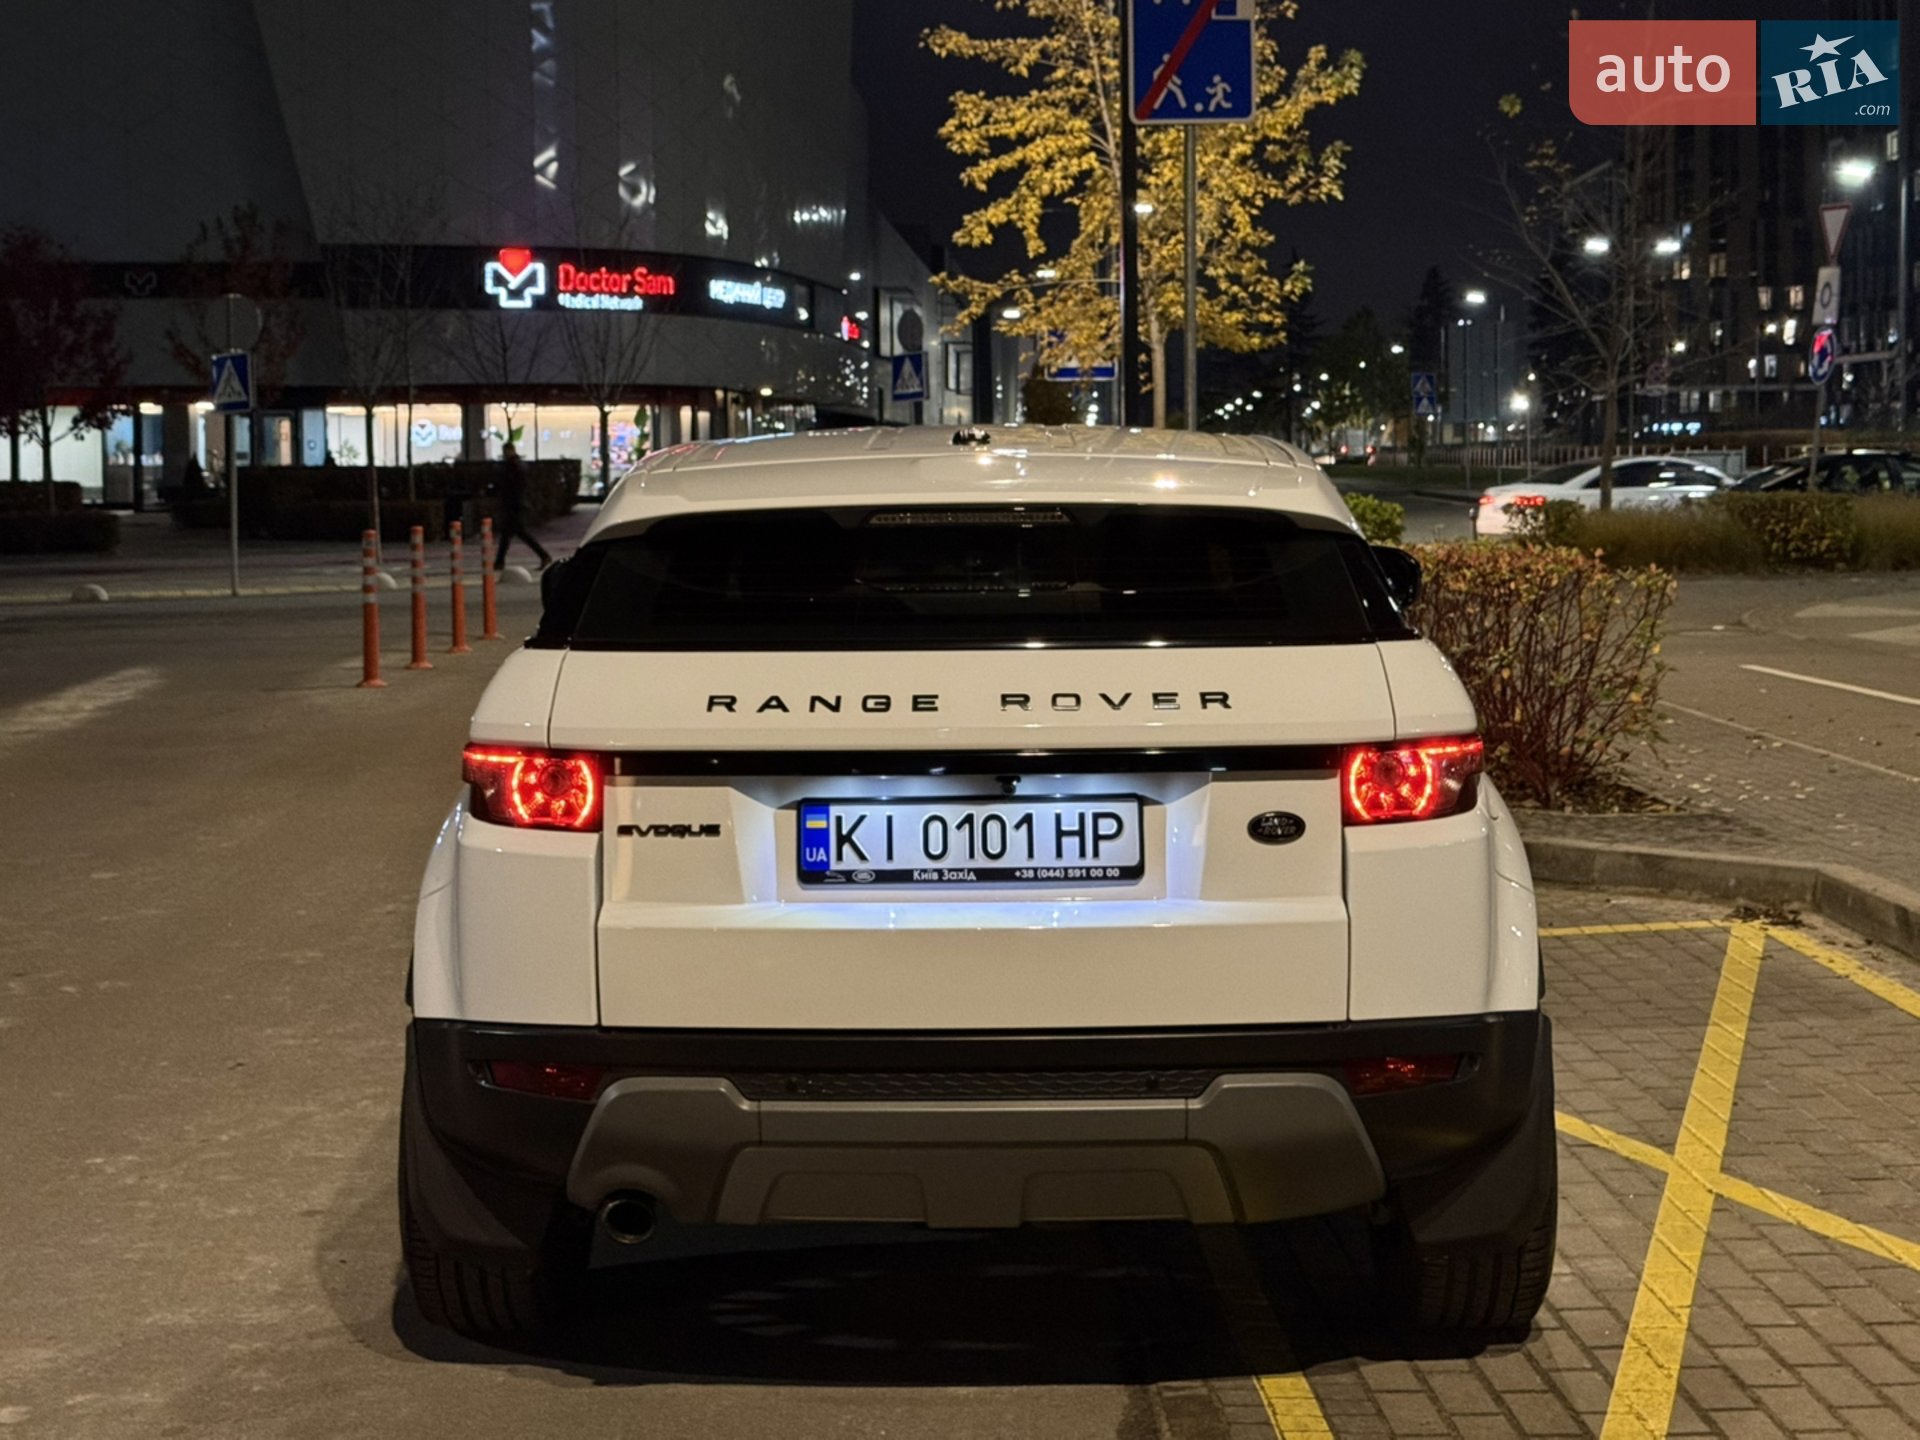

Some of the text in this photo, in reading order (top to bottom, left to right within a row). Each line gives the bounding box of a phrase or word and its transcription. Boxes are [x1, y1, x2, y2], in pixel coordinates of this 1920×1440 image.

[558, 263, 675, 295] Doctor Sam
[706, 691, 1232, 713] RANGE ROVER
[617, 824, 721, 838] EVOQUE
[835, 811, 1124, 862] KI 0101 HP
[806, 847, 828, 862] UA
[913, 869, 977, 882] Київ Захід
[1014, 867, 1120, 879] +38 (044) 591 00 00
